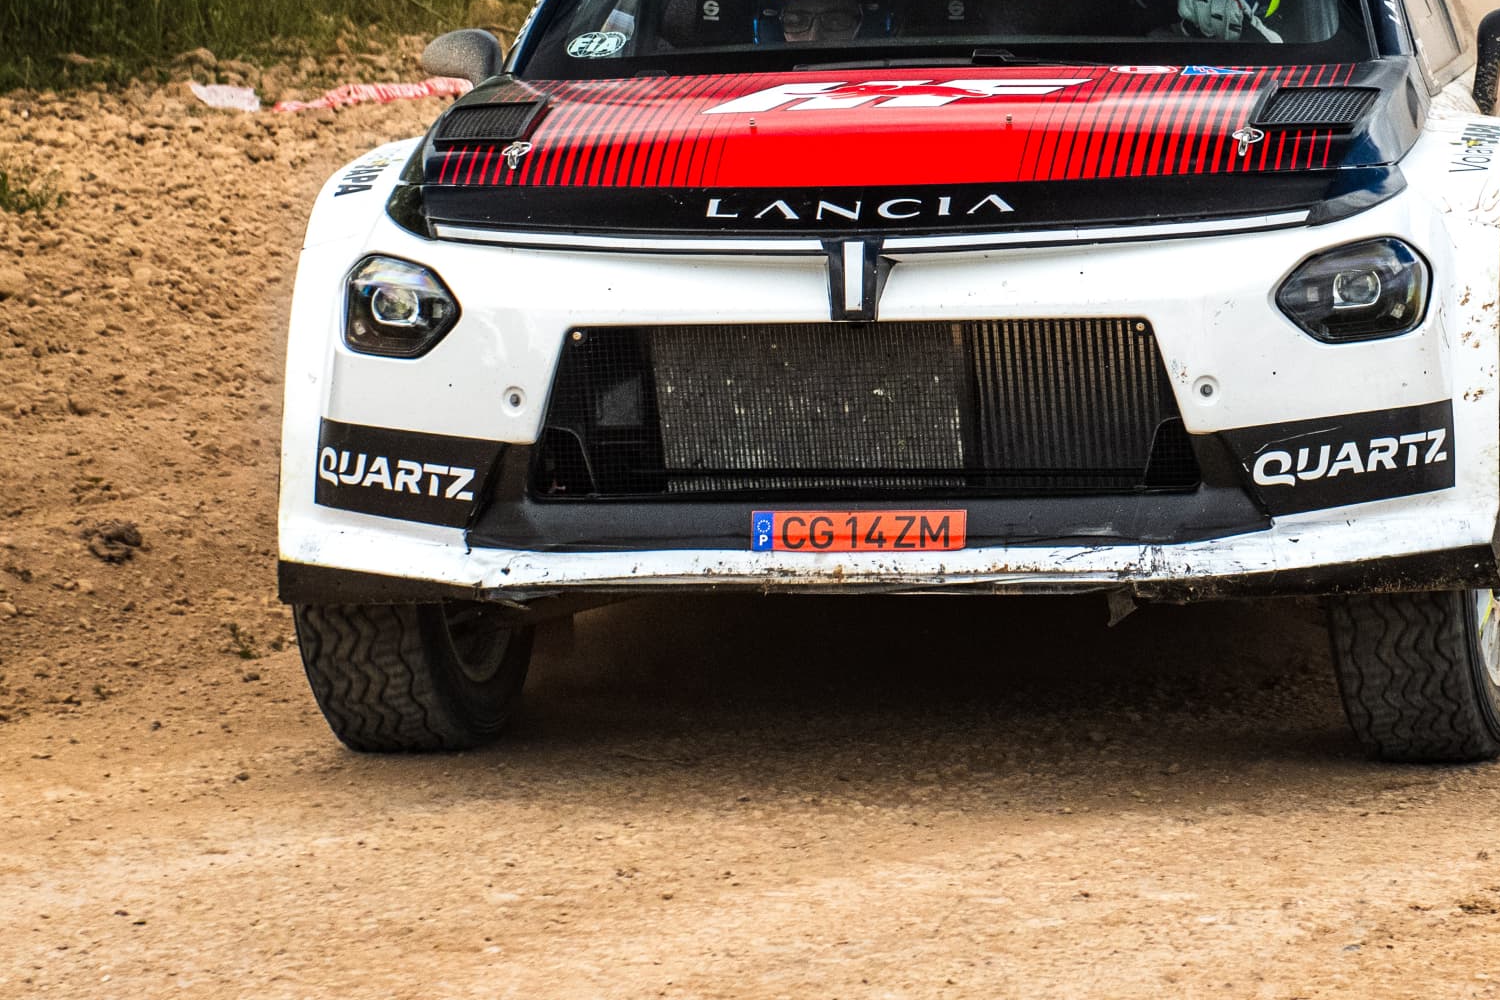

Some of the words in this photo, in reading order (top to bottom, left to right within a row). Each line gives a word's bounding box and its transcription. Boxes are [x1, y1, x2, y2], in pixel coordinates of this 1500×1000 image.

[568, 34, 622, 55] FIA
[706, 193, 1016, 221] LANCIA
[1252, 428, 1448, 487] QUARTZ
[319, 446, 476, 502] QUARTZ
[758, 534, 769, 547] P
